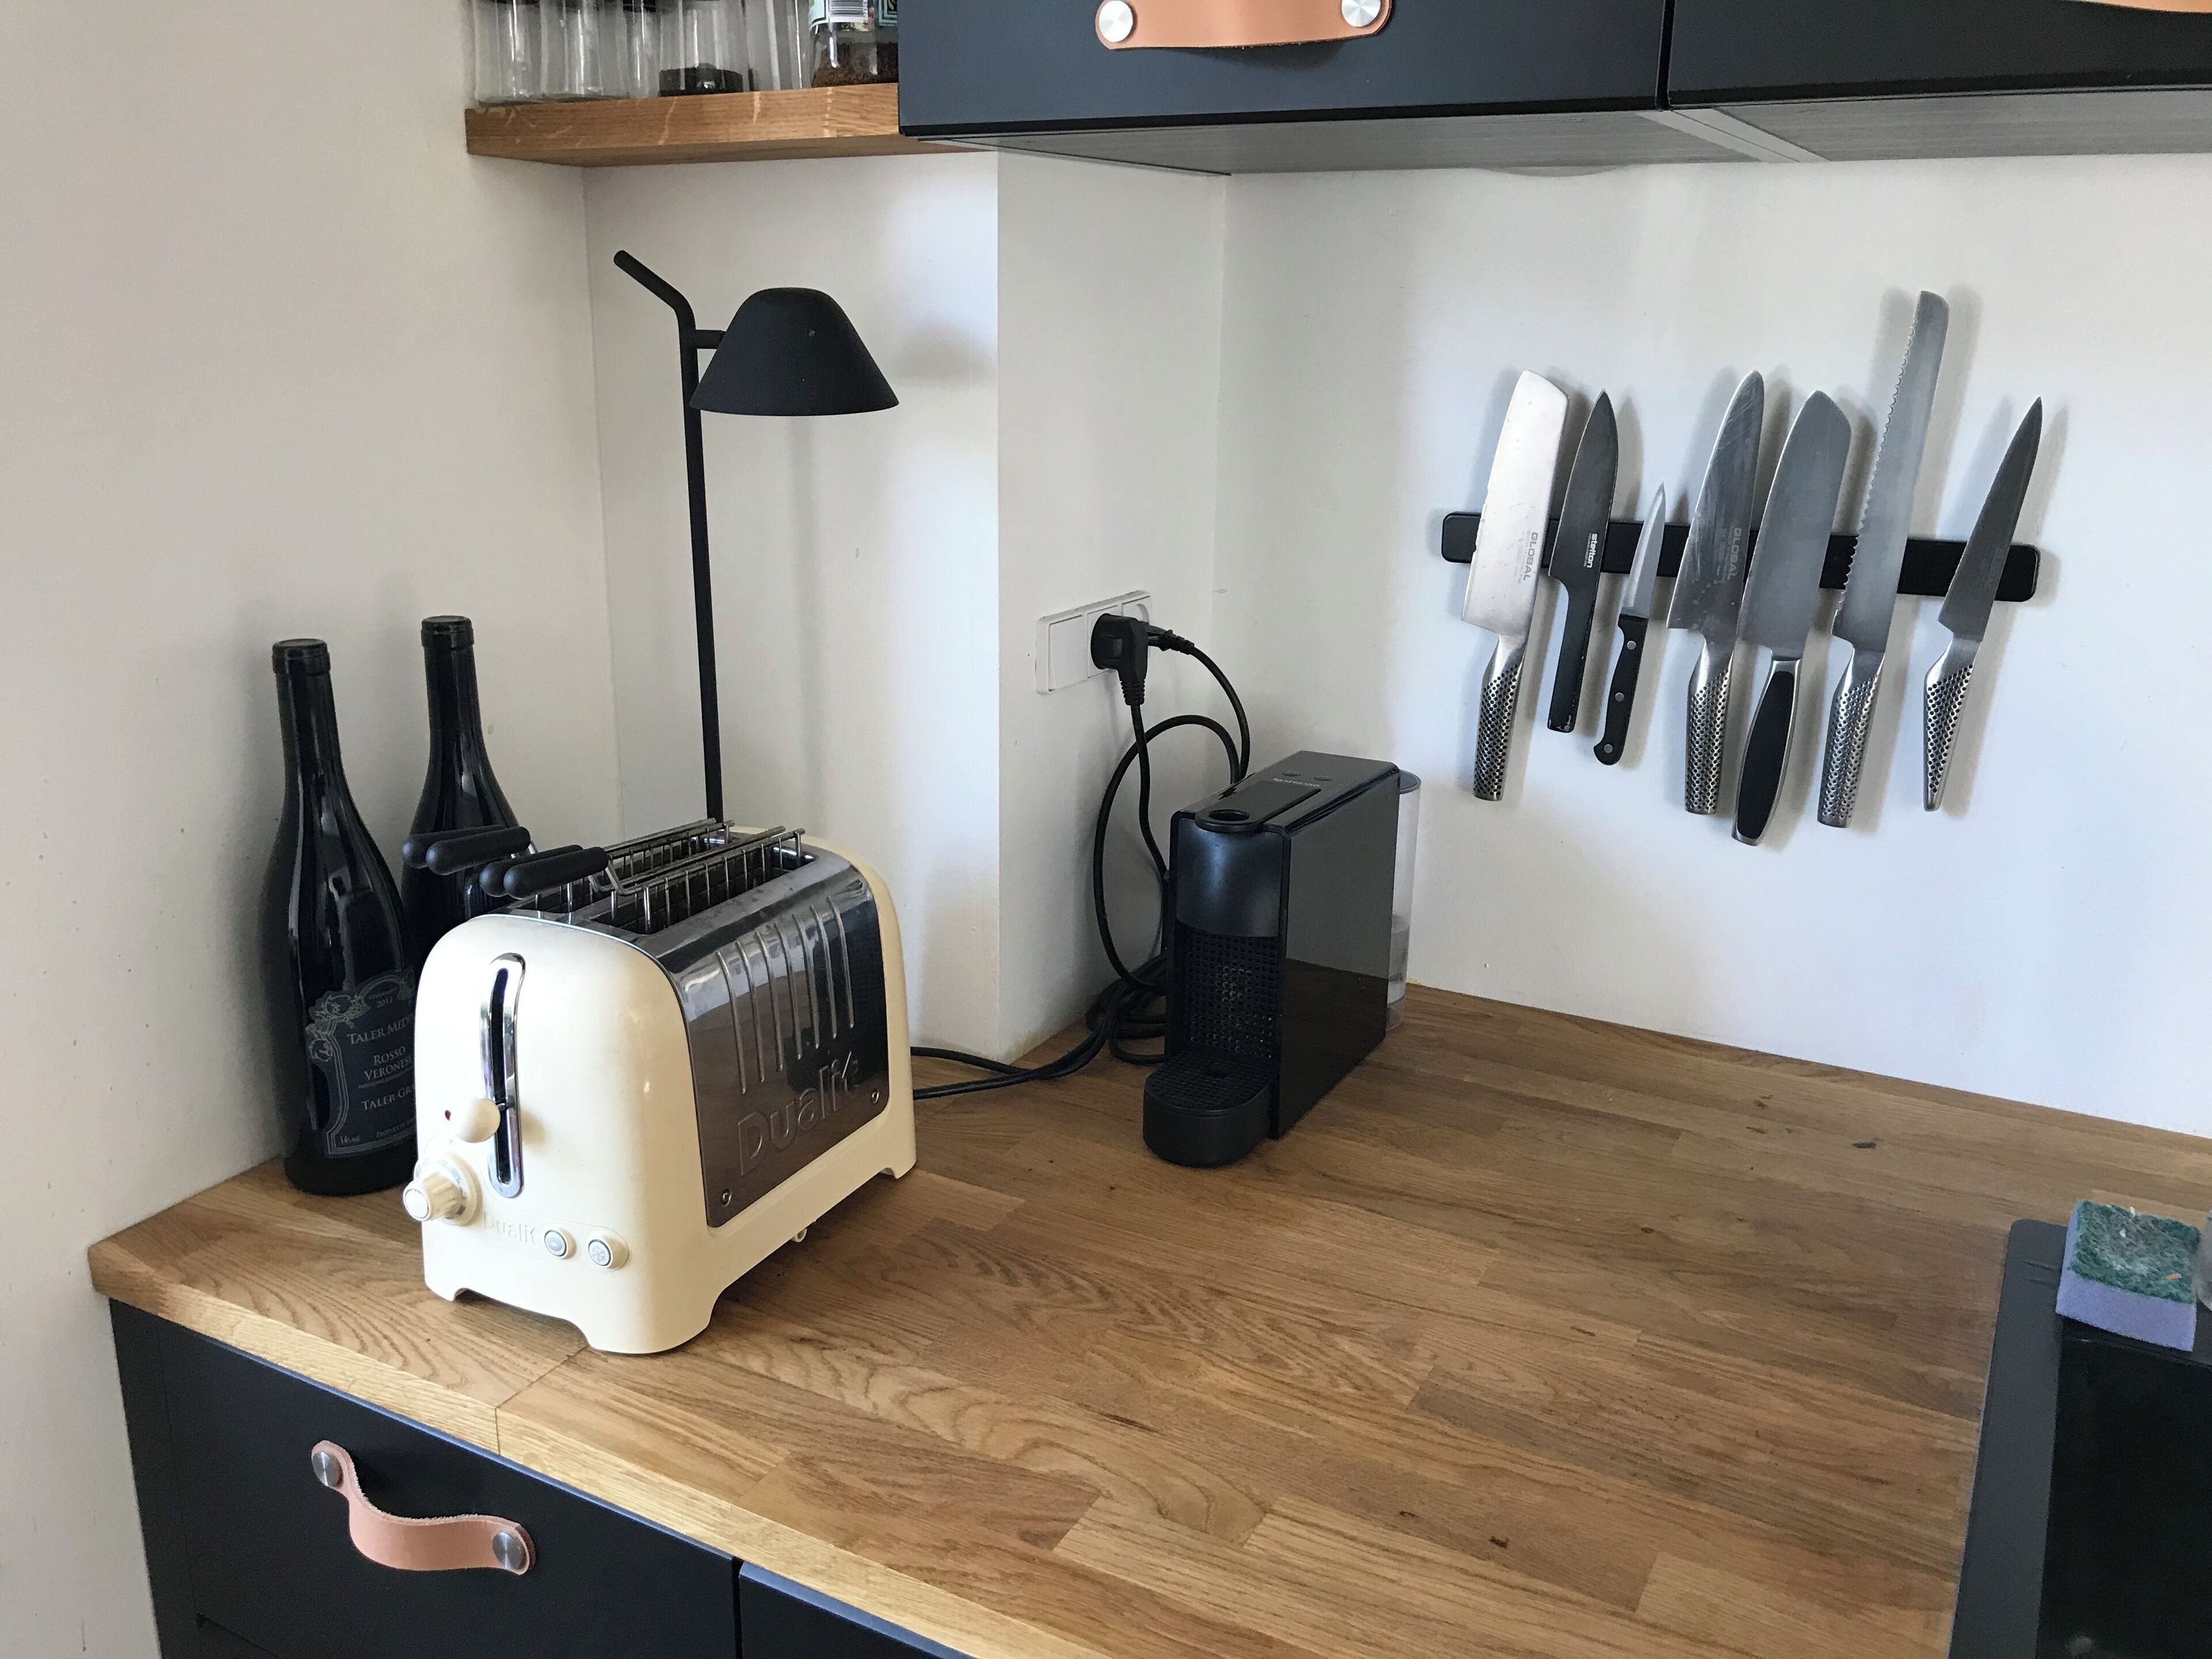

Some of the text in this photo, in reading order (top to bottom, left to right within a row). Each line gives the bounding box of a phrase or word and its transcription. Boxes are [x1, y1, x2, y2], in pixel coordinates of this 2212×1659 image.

[1523, 532, 1539, 581] GLOBAL
[1586, 533, 1597, 568] stelton
[1728, 528, 1743, 580] GLOBAL
[347, 1028, 386, 1045] TALER
[373, 1046, 406, 1066] ROSSO
[361, 1093, 396, 1111] TALER
